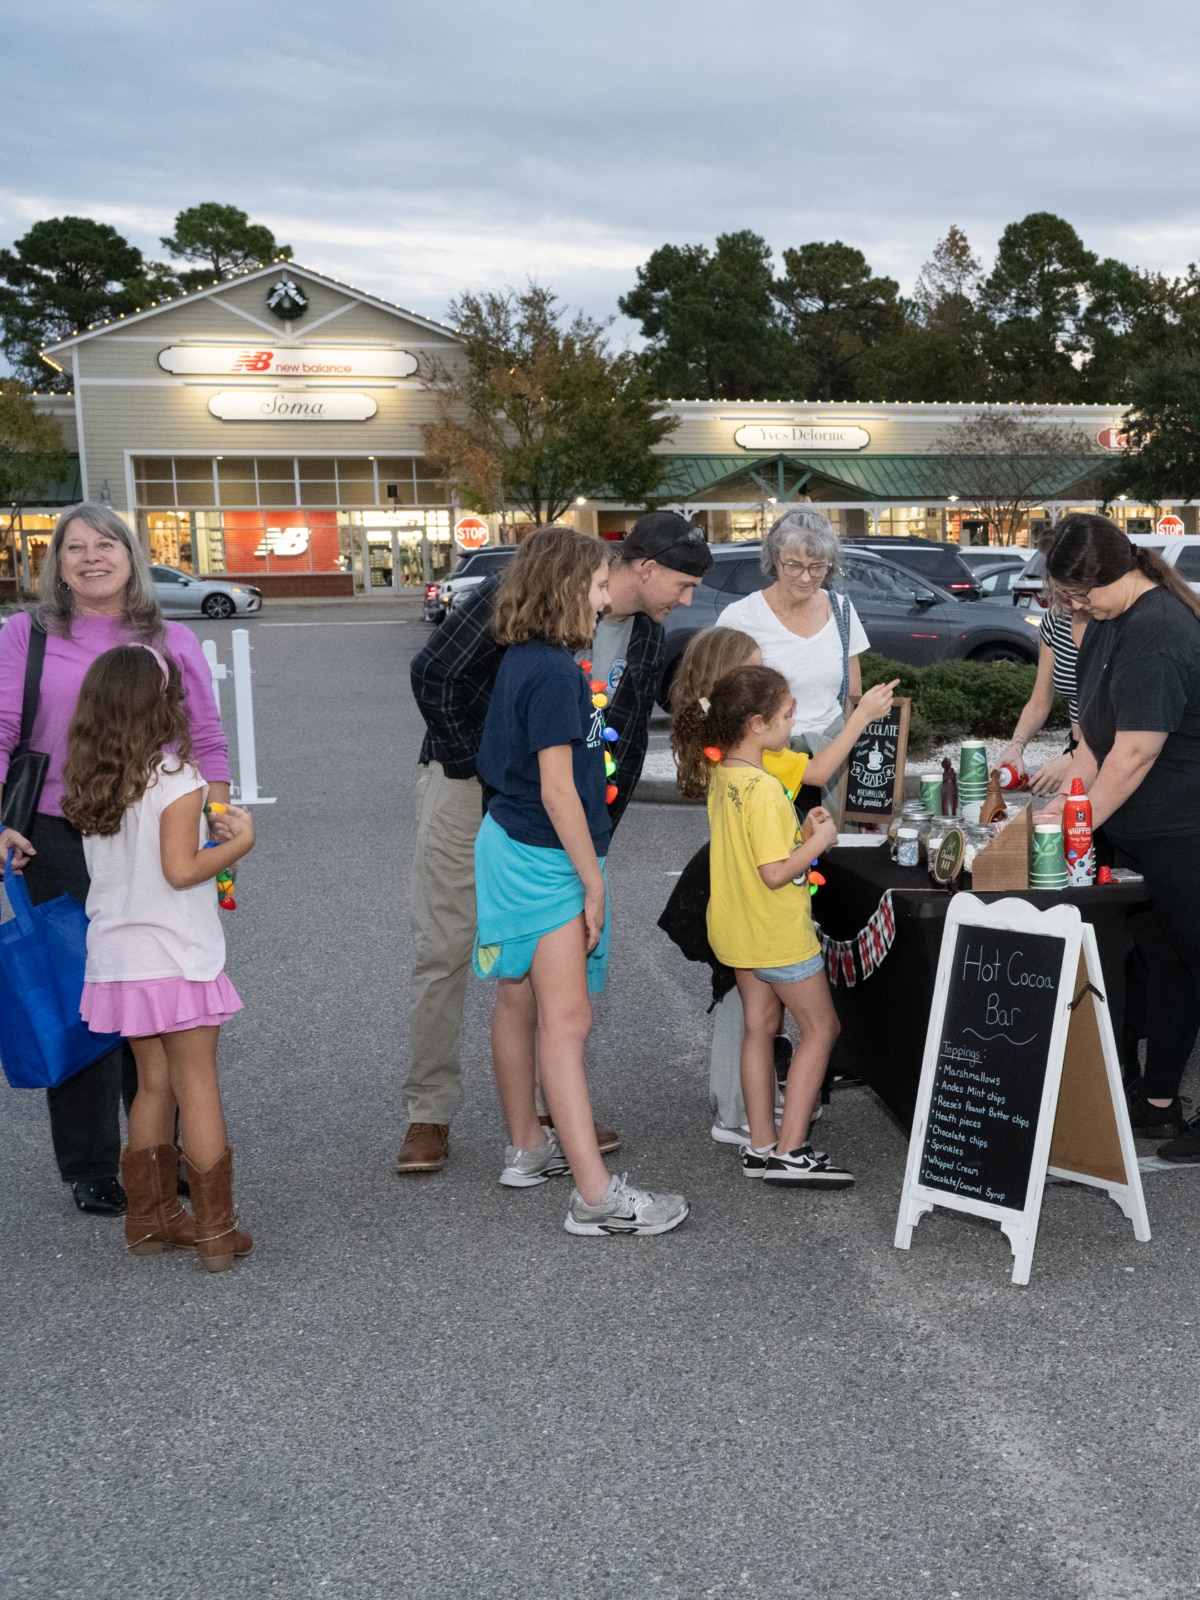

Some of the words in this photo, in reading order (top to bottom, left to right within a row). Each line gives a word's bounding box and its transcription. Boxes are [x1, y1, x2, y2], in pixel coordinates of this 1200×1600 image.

[276, 364, 300, 373] new
[302, 362, 352, 374] balance
[261, 394, 327, 415] Soma
[760, 427, 789, 441] Yves
[792, 427, 847, 441] Delorme
[457, 526, 486, 540] STOP
[1159, 524, 1182, 535] STOP
[862, 773, 883, 787] BAR
[962, 944, 1001, 982] Hot
[1006, 950, 1055, 990] Cocoa
[985, 992, 1021, 1026] Bar
[943, 1065, 1001, 1086] Marshmallows
[941, 1080, 964, 1094] Andes
[966, 1085, 986, 1098] Mint
[986, 1093, 1006, 1106] chips
[935, 1109, 957, 1124] Heath
[959, 1116, 982, 1129] pieces
[937, 1094, 962, 1110] Reese's
[965, 1101, 986, 1114] Peanut
[988, 1106, 1010, 1121] Butter
[1011, 1114, 1030, 1129] chips
[932, 1124, 966, 1142] Chocolate
[969, 1135, 988, 1149] chips
[930, 1139, 964, 1156] Sprinkles
[928, 1154, 955, 1170] Whipped
[956, 1162, 979, 1177] Cream
[985, 1187, 1006, 1201] Syrup
